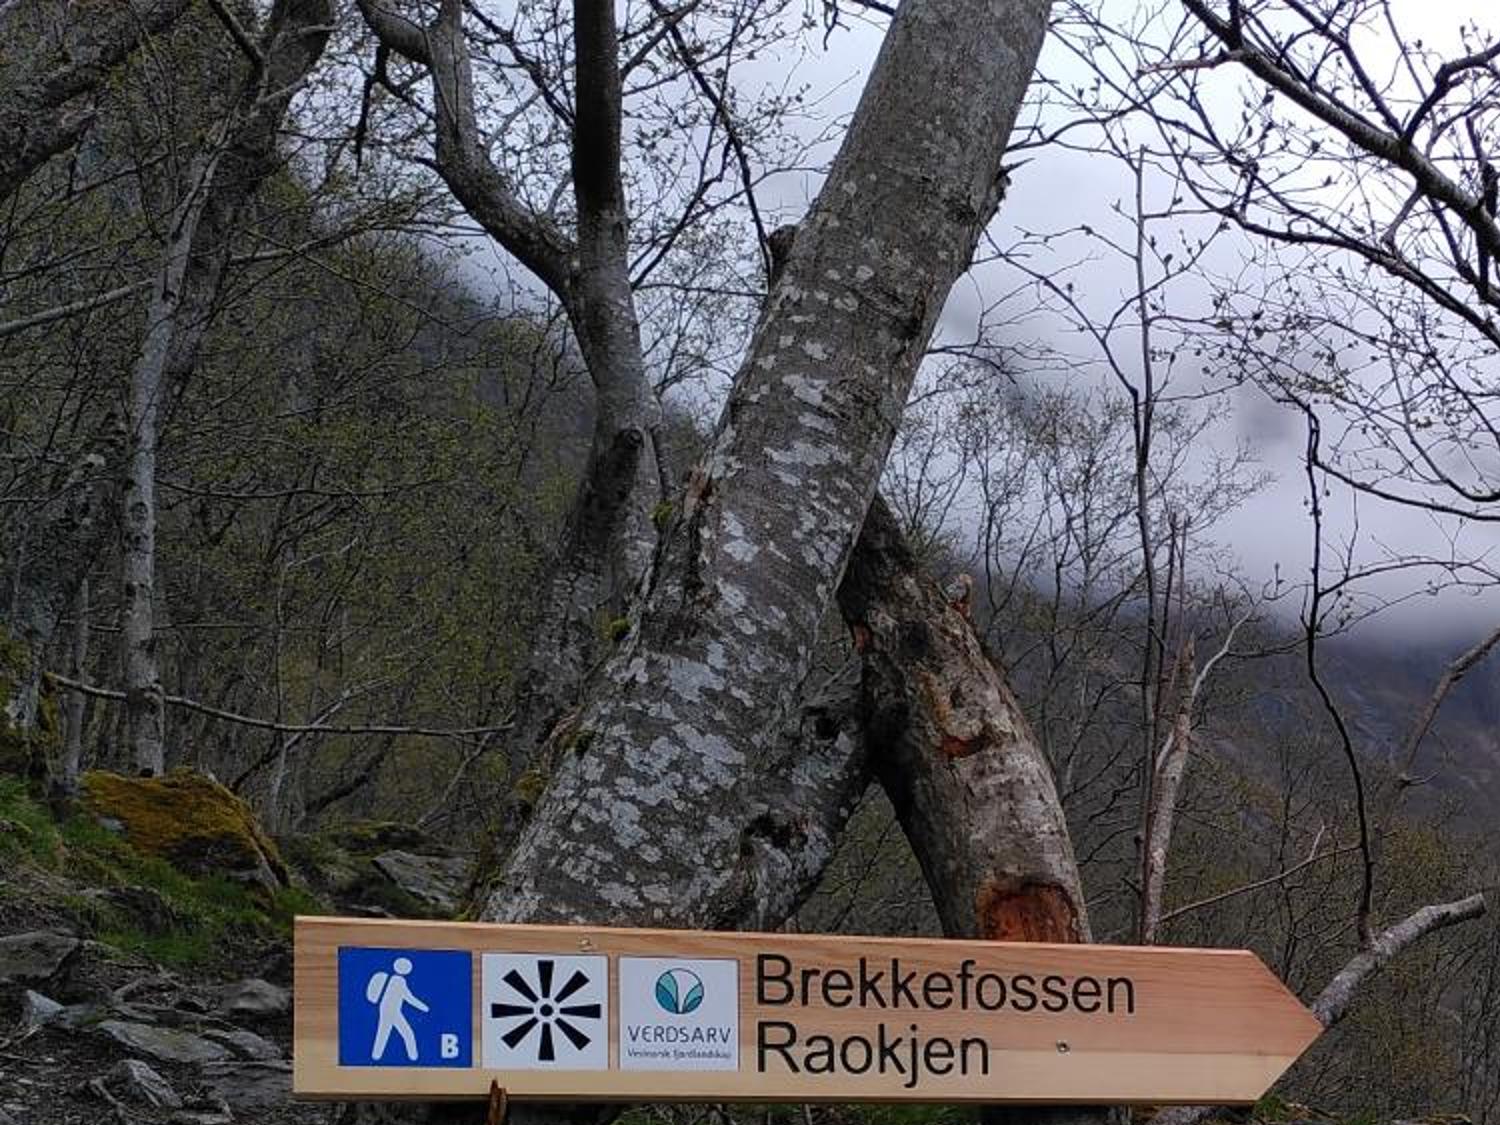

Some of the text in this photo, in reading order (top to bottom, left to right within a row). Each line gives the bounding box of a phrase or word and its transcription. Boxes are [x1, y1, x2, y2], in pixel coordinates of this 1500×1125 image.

[757, 953, 1135, 1013] Brekkefossen
[441, 1033, 459, 1059] B
[627, 1025, 732, 1043] VERDSARV
[757, 1021, 989, 1088] Raokjen
